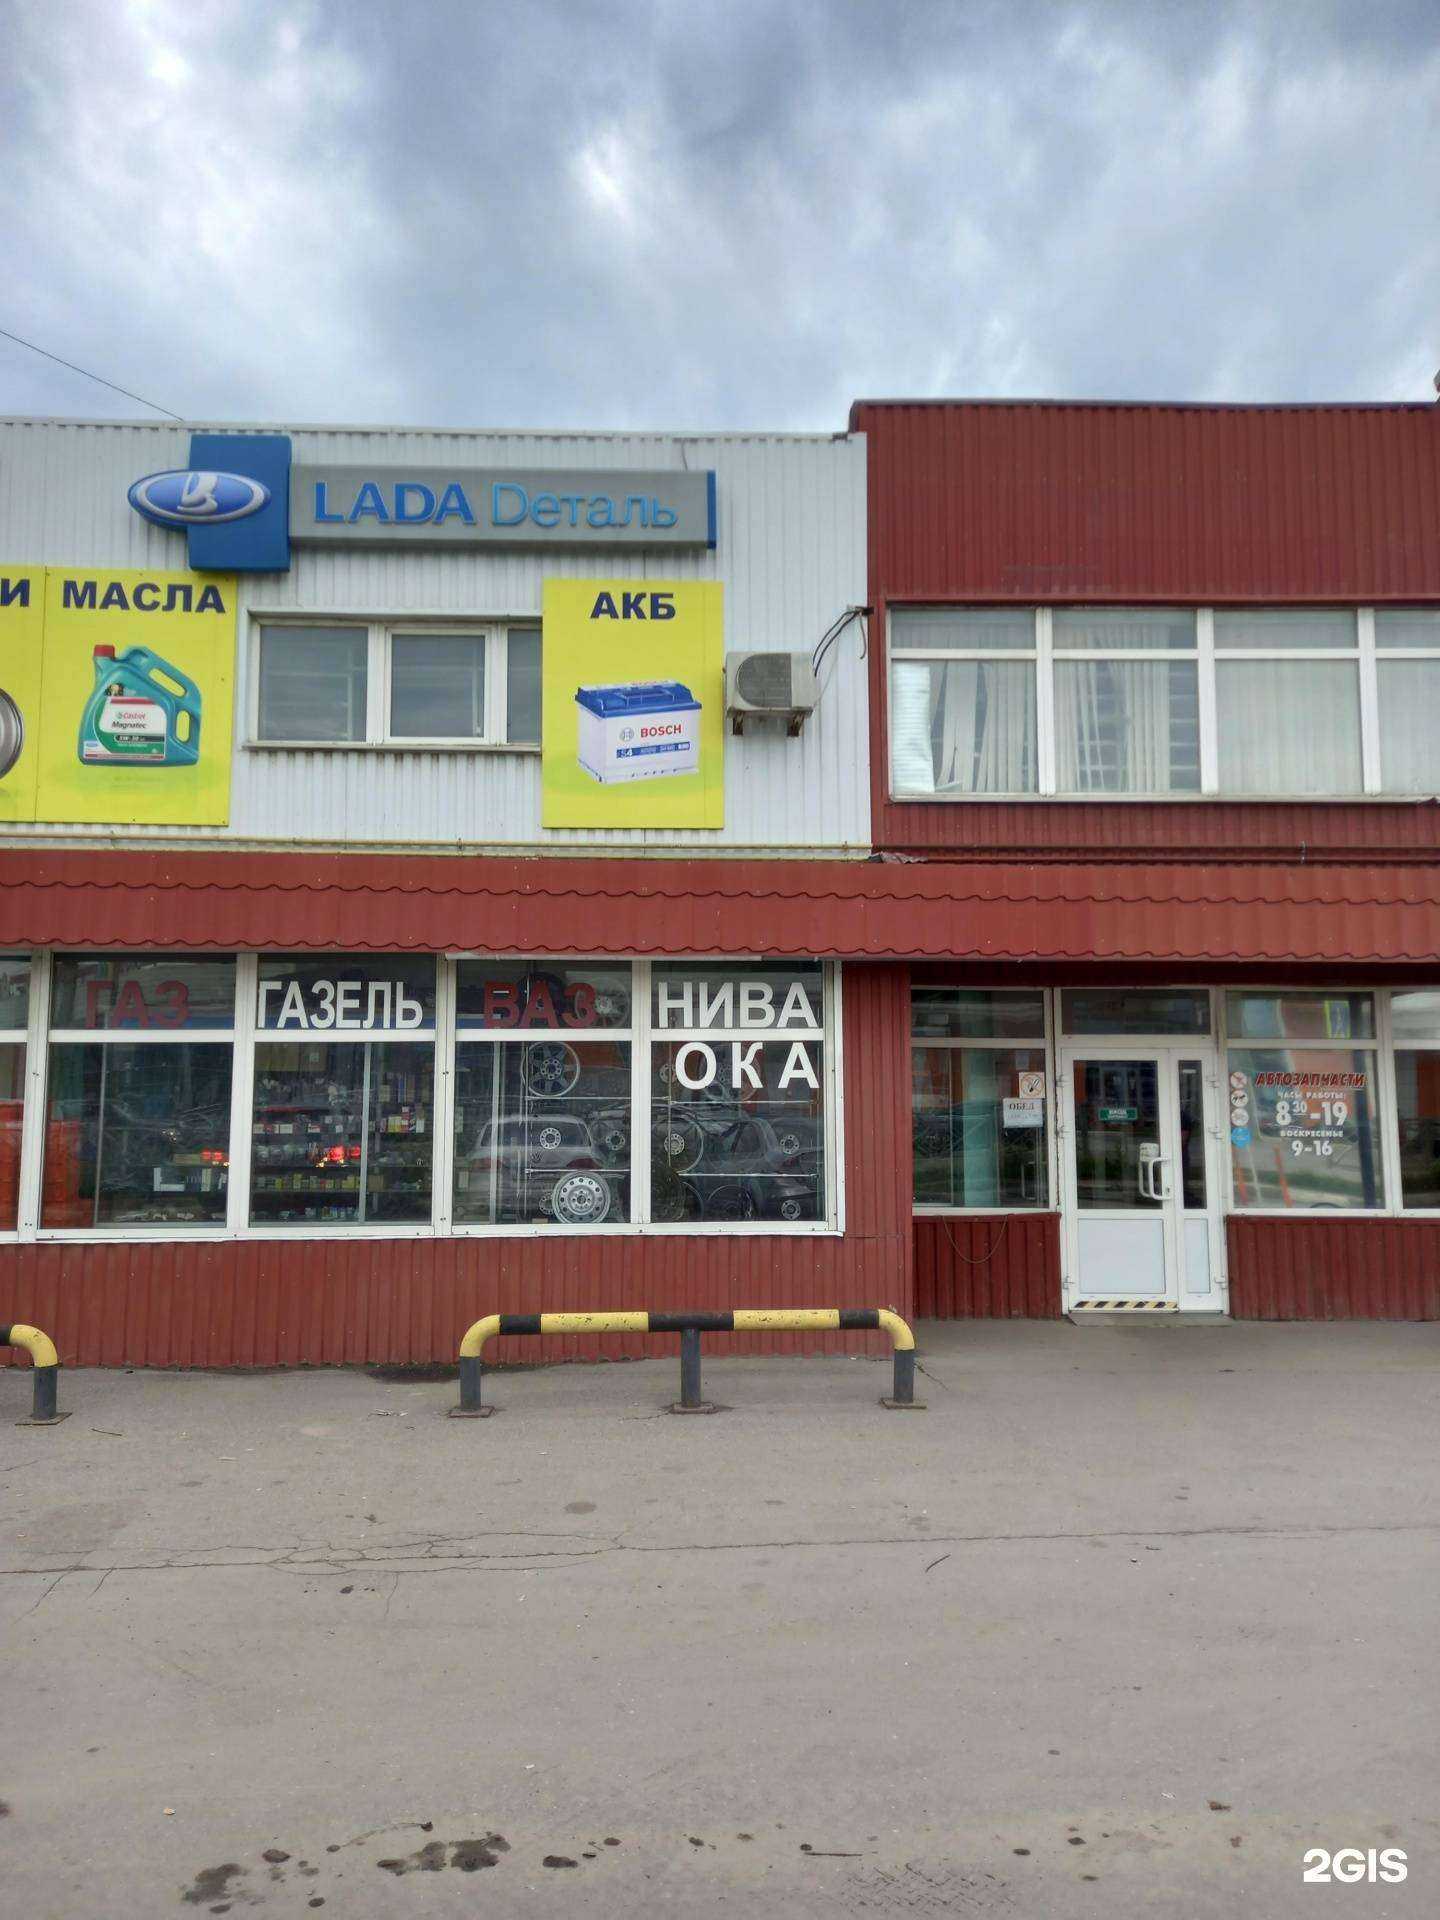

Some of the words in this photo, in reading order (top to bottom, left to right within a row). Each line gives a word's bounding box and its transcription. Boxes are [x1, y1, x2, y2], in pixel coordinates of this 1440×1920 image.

[313, 481, 476, 525] LADA
[62, 579, 226, 614] МАСЛА
[590, 591, 676, 620] АКБ
[640, 724, 682, 738] BOSCH
[86, 980, 190, 1028] ГАЗ
[257, 980, 423, 1029] ГАЗЕЛЬ
[484, 981, 597, 1029] ВАЗ
[657, 982, 819, 1029] НИВА
[1255, 1072, 1366, 1087] АВТОЗАПЧАСТИ
[1280, 1130, 1344, 1138] ВОСКРЕСЕНЬЕ
[1291, 1140, 1333, 1157] 9-16
